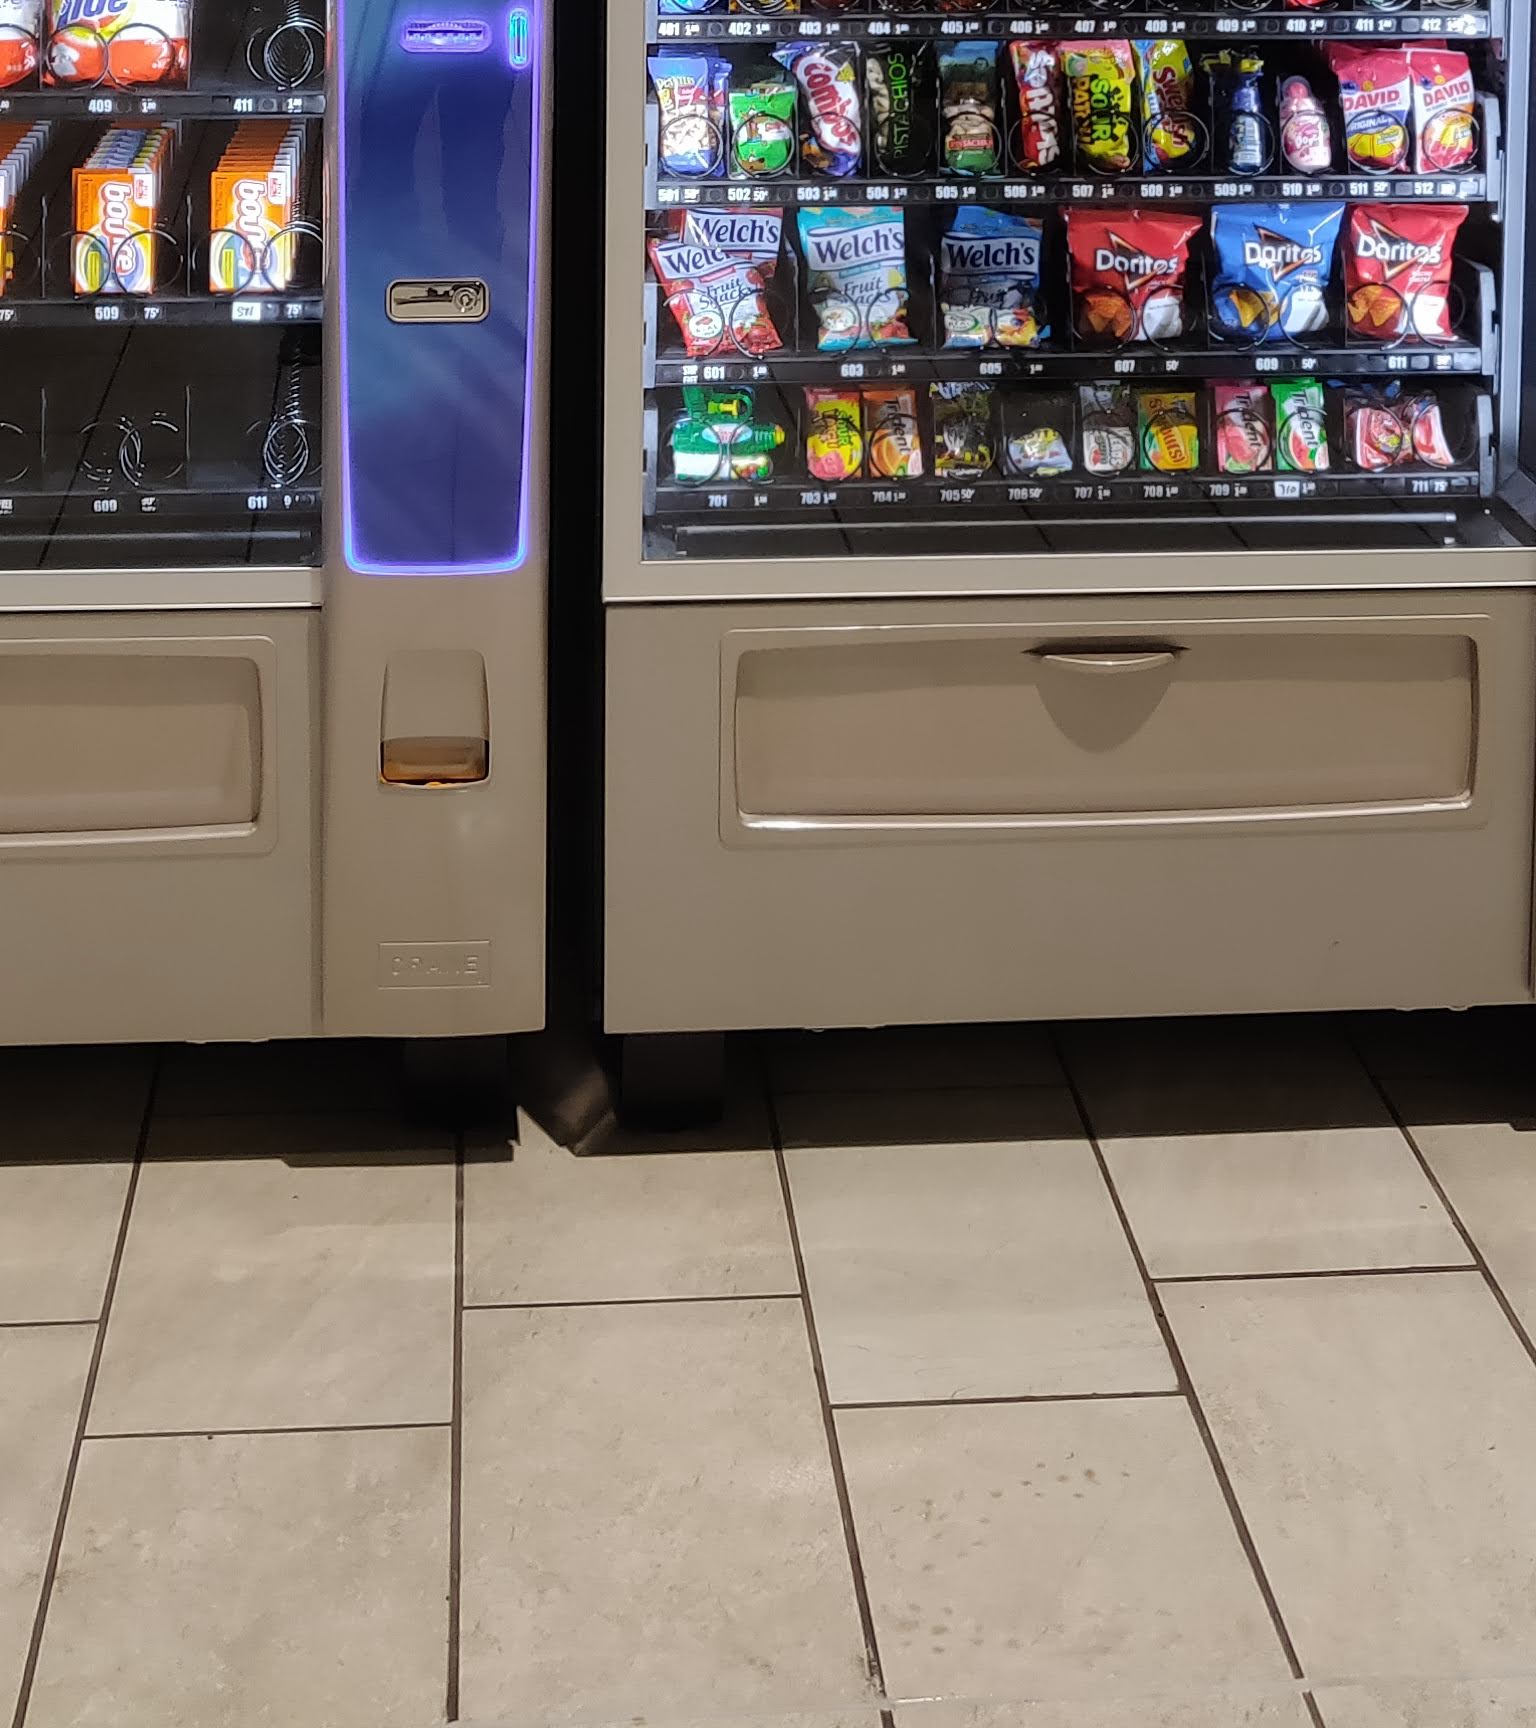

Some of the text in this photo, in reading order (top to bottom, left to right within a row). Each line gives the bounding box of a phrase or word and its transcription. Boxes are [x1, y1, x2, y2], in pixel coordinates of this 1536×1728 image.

[728, 21, 752, 36] 402
[1285, 18, 1308, 33] 410
[1421, 17, 1442, 32] 412
[1343, 89, 1401, 111] DAVID
[1423, 80, 1472, 105] DAVID
[233, 97, 253, 113] 411
[804, 62, 857, 147] Combos
[887, 52, 910, 159] PISTACHIOS
[1090, 78, 1113, 141] SOUR
[727, 187, 751, 202] 502
[1414, 181, 1435, 195] 512
[693, 218, 779, 245] Welch's
[813, 228, 905, 266] Welch's
[947, 242, 1036, 267] Welch's
[1244, 242, 1323, 265] Doritos
[1357, 236, 1441, 264] Doritos
[1096, 249, 1178, 275] Doritos
[844, 278, 883, 295] Fruit
[703, 365, 725, 380] 601
[1388, 355, 1408, 370] 611
[884, 399, 912, 455] Trident
[1235, 393, 1263, 450] Trident
[1291, 390, 1319, 449] Trident
[1411, 480, 1429, 493] 711
[247, 495, 268, 510] 611
[708, 494, 728, 507] 701
